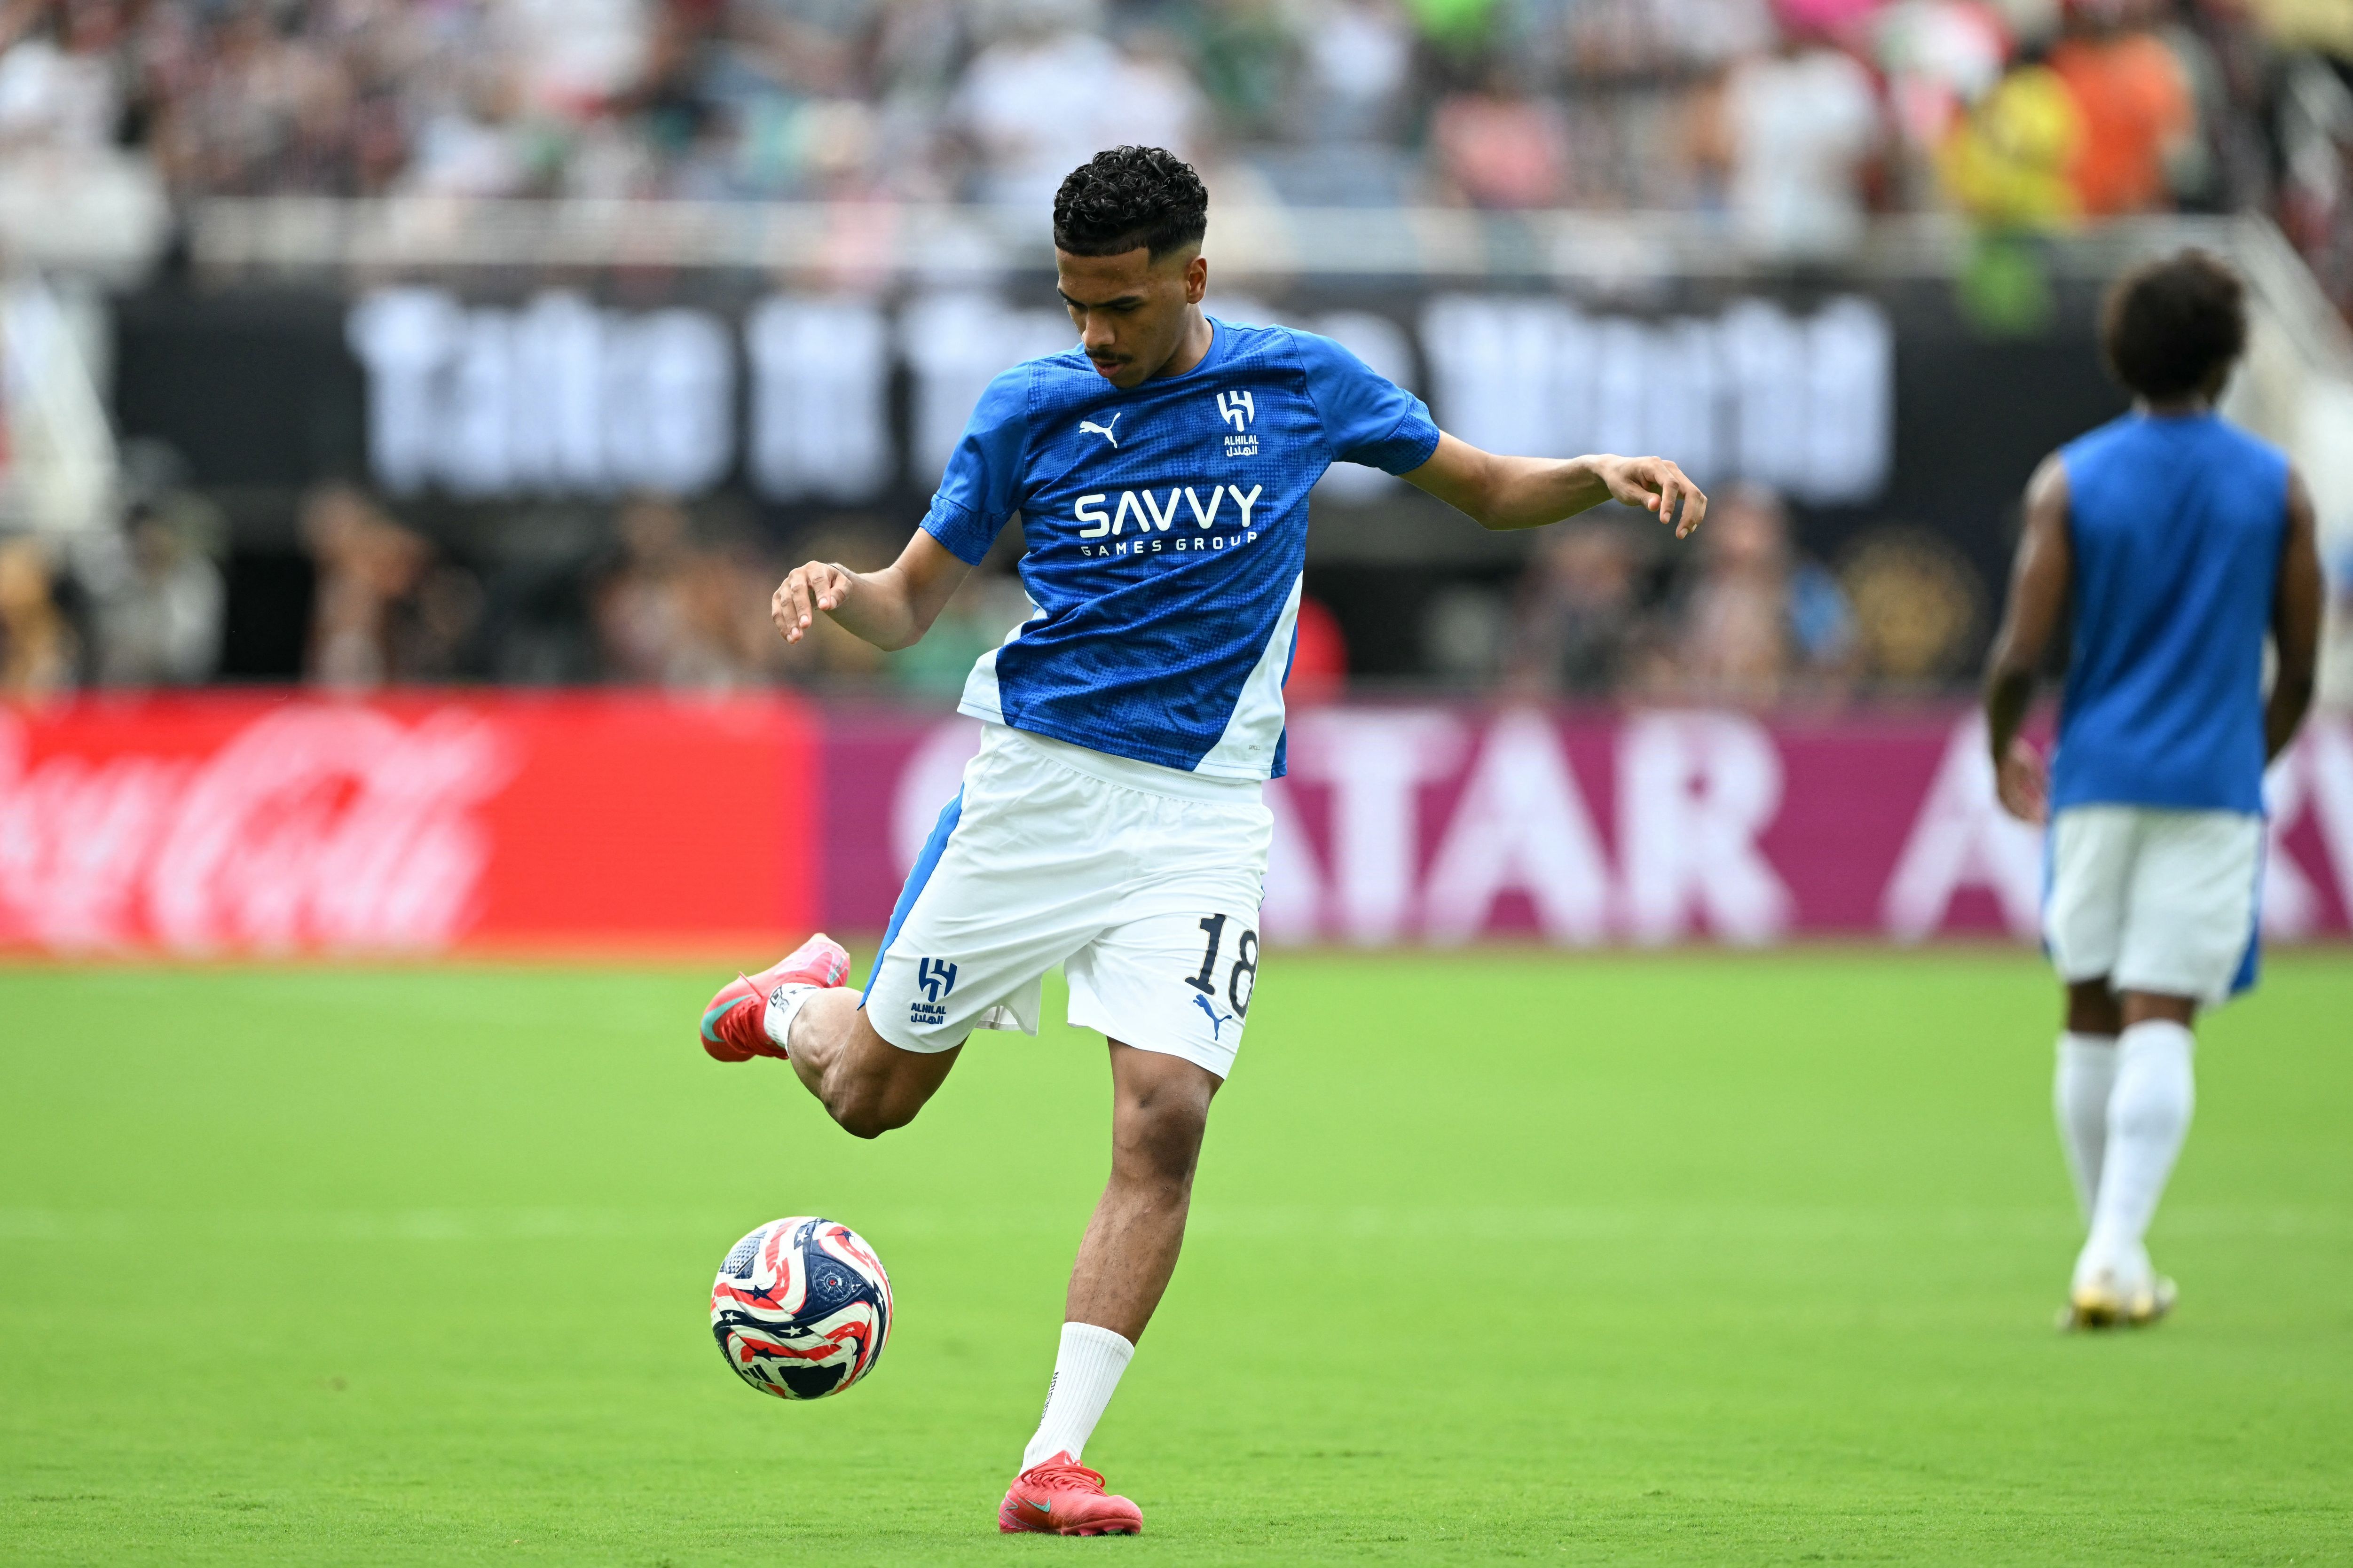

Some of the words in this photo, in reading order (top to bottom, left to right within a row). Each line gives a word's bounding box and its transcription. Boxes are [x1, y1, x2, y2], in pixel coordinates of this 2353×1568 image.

[1224, 435, 1259, 446] ALHILAL
[1226, 446, 1258, 457] الهلال
[1075, 484, 1262, 538] SAVVY
[1081, 540, 1162, 557] GAMES
[1176, 531, 1257, 550] GROUP
[1184, 913, 1259, 1019] 18
[911, 1003, 946, 1014] ALHILAL
[910, 1013, 944, 1025] الهلال
